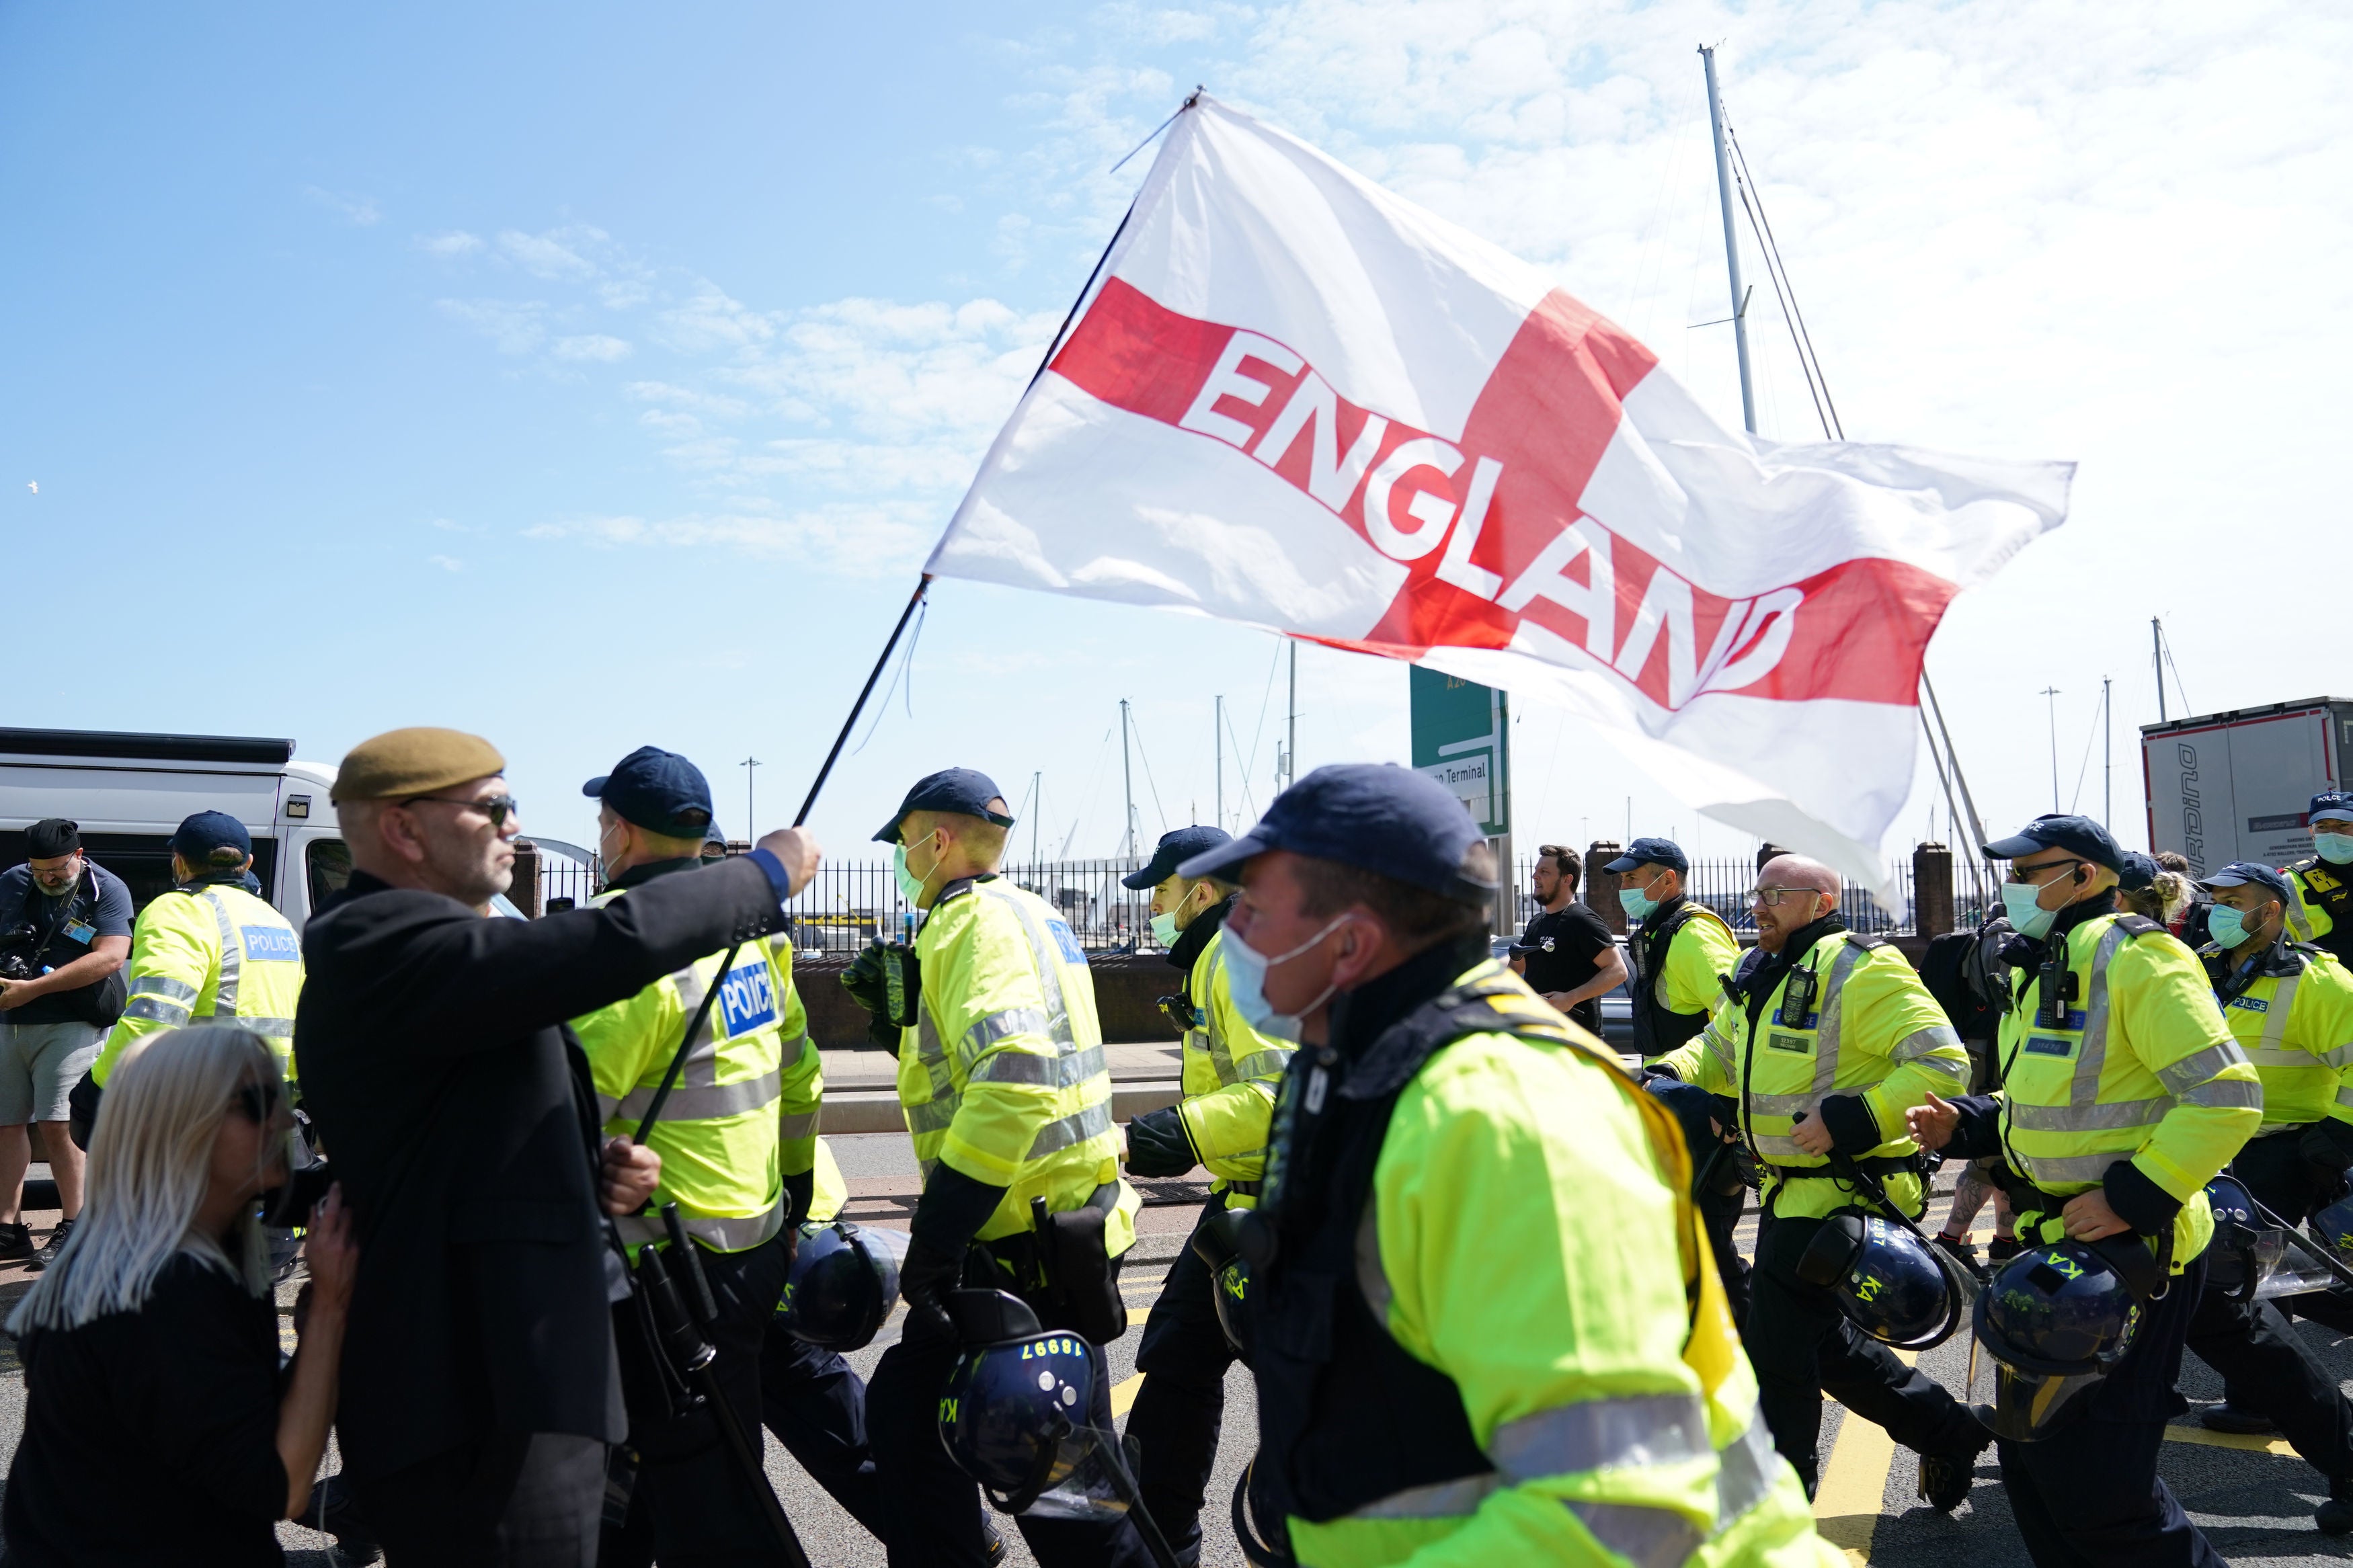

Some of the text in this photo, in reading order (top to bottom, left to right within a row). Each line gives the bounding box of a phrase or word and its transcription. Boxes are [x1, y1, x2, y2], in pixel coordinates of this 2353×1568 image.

[1178, 330, 1805, 710] ENGLAND
[1446, 762, 1485, 784] Terminal
[247, 934, 296, 953] POLICE
[2234, 997, 2266, 1011] POLICE
[1780, 1037, 1796, 1045] 12397
[2047, 1252, 2085, 1281] KA
[1856, 1275, 1882, 1303] KA
[1021, 1339, 1082, 1360] 18997
